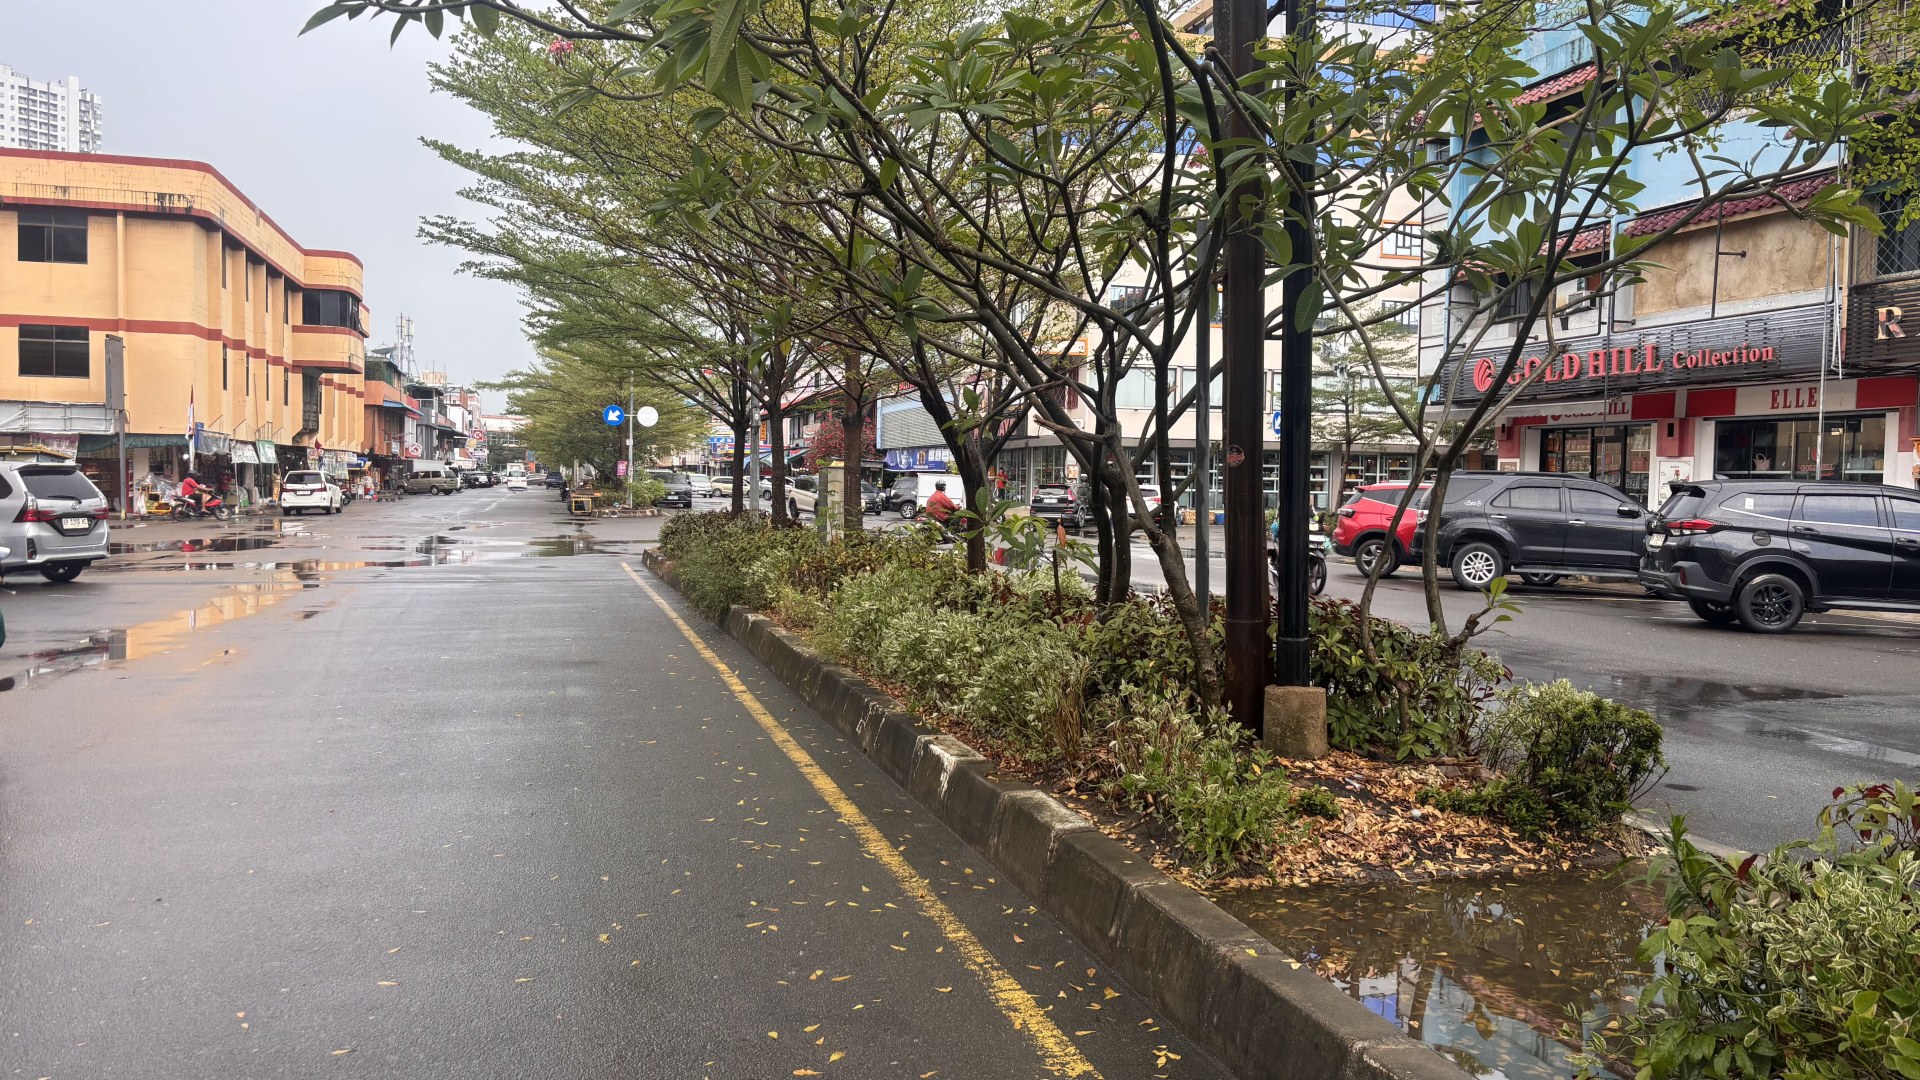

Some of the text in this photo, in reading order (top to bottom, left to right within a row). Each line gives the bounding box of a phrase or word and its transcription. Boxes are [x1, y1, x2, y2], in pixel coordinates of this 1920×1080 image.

[1873, 306, 1920, 340] R
[1507, 342, 1774, 385] GOLD HILL Collection
[1770, 386, 1817, 410] ELLE
